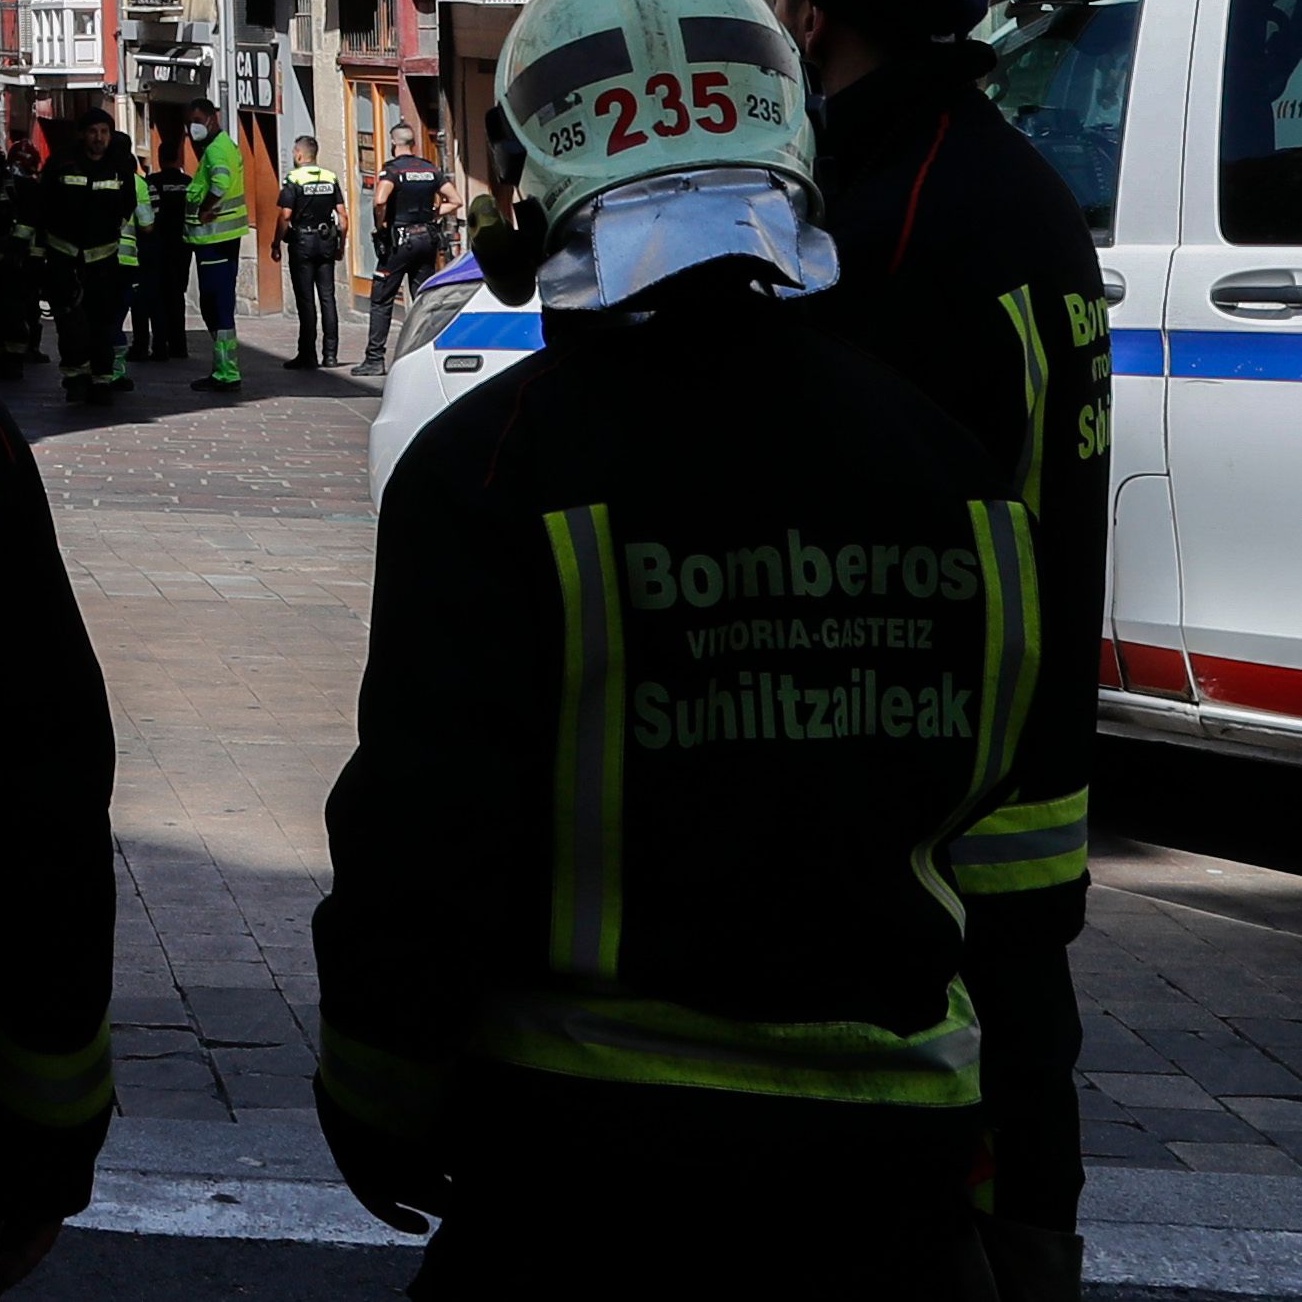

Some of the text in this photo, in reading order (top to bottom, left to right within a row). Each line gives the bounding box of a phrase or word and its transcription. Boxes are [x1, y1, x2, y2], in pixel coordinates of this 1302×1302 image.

[549, 121, 586, 157] 235
[595, 71, 738, 157] 235
[746, 94, 782, 126] 235
[626, 528, 979, 610] Bomberos
[687, 617, 933, 660] VITORIA-GASTEIZ
[634, 667, 973, 749] Suhiltzaileak
